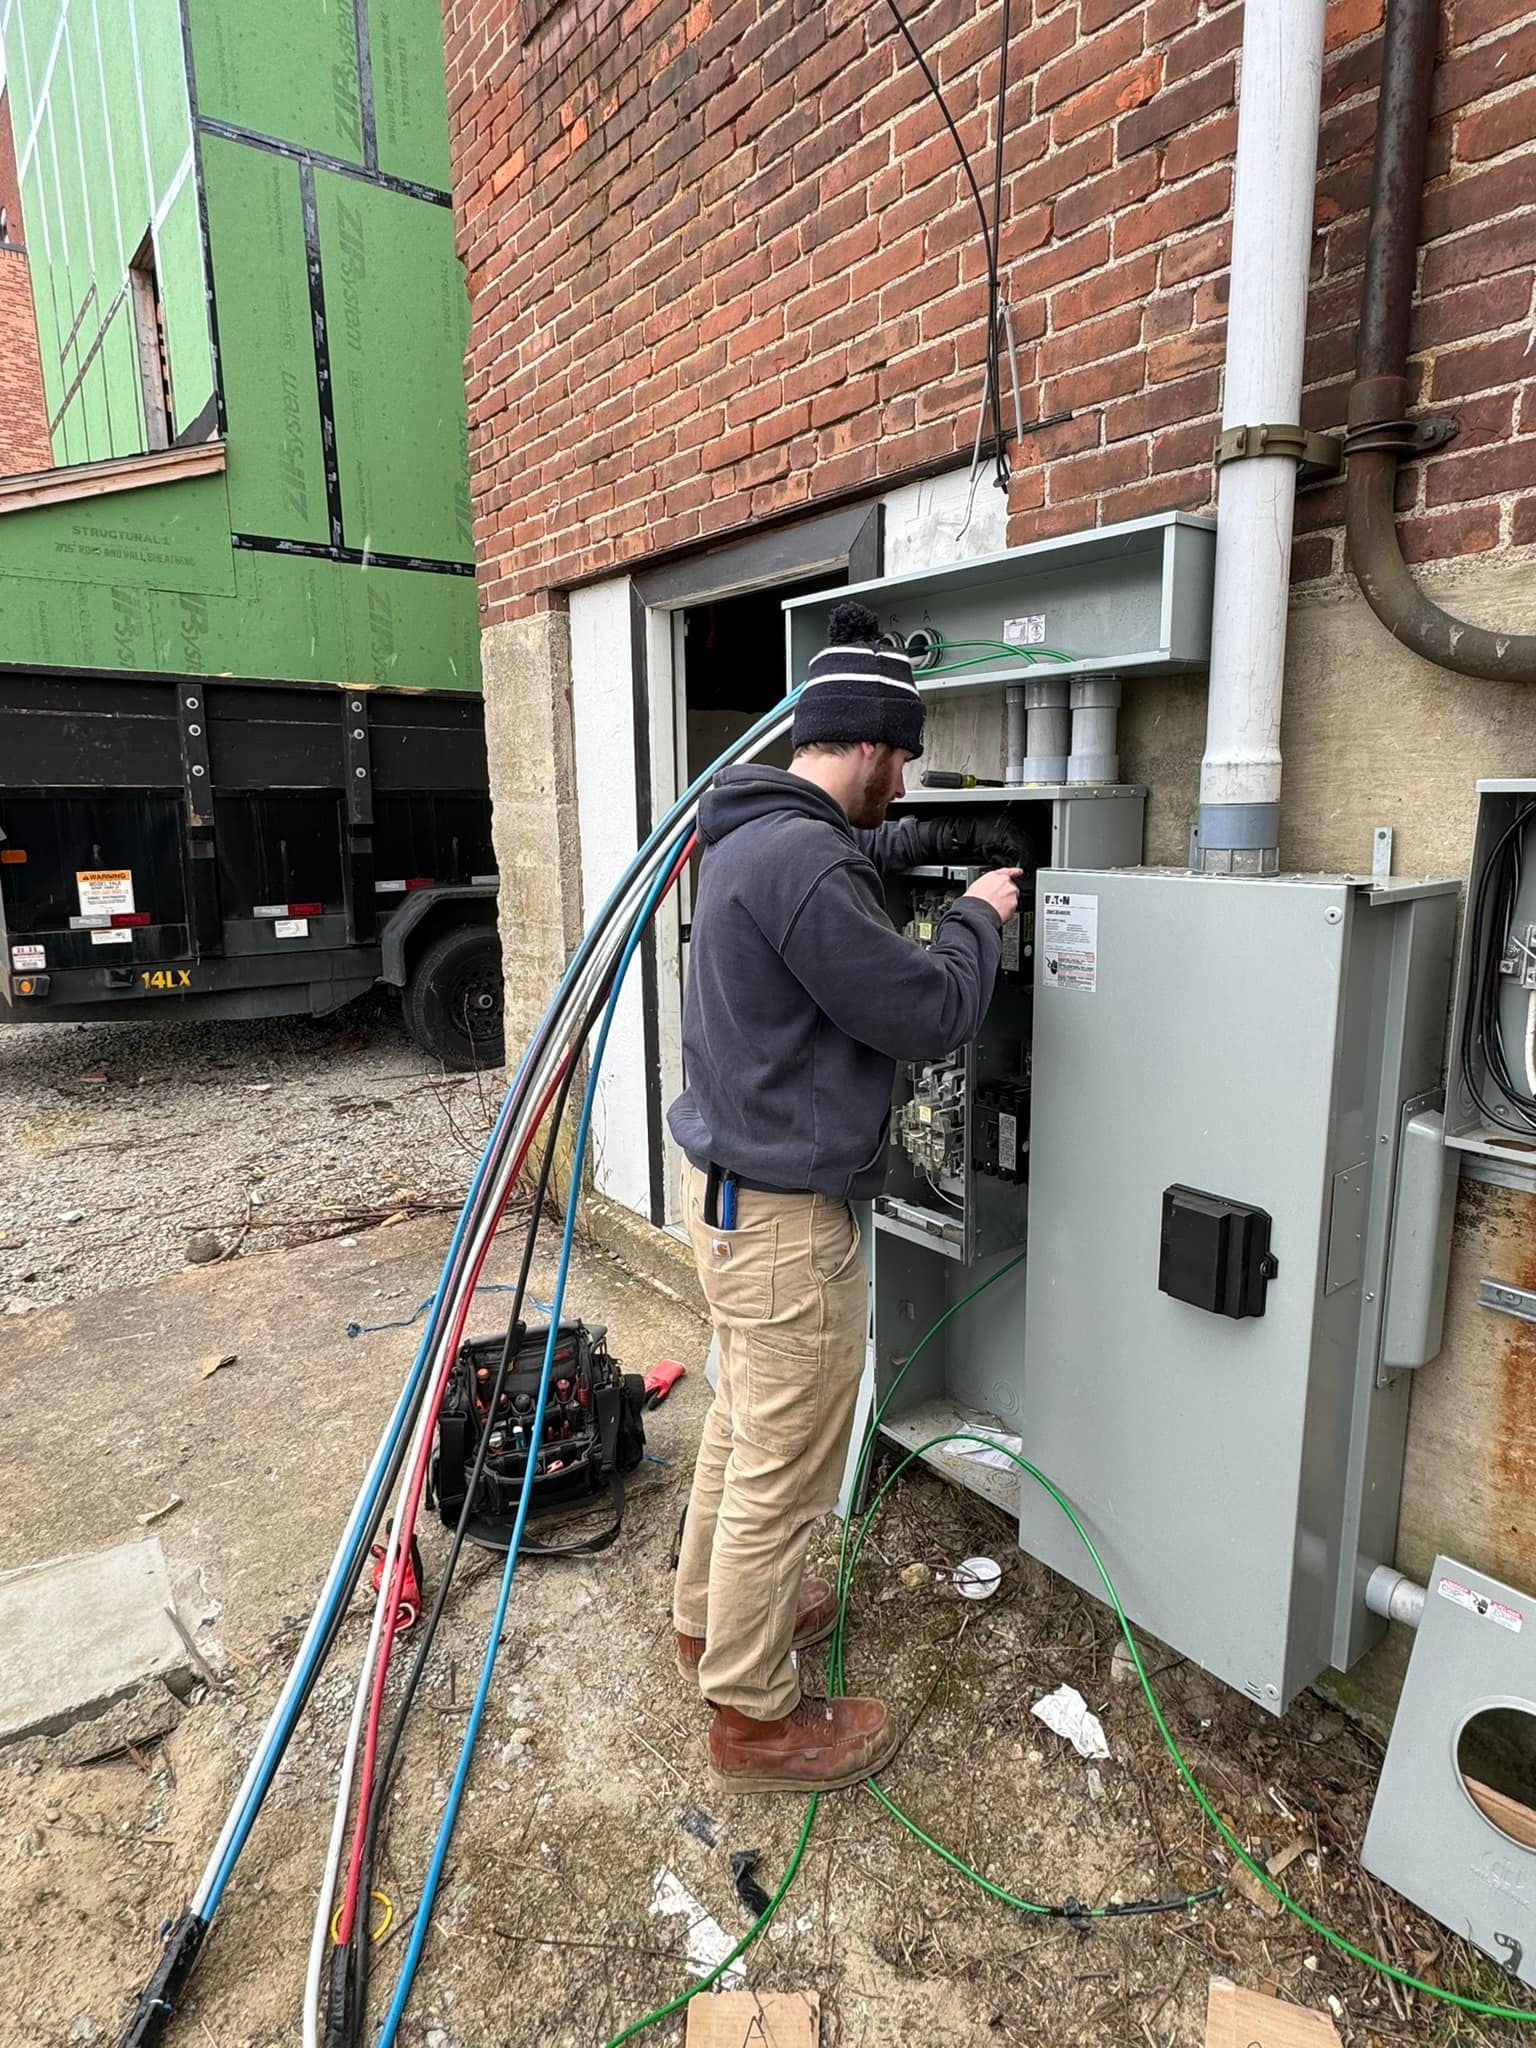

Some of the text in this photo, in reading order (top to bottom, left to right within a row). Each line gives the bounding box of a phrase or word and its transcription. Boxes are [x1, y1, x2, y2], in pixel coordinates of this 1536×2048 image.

[72, 525, 161, 545] STRUCTURAL
[123, 551, 144, 562] WALL
[89, 872, 127, 881] WARNING
[1045, 895, 1070, 905] EATON
[141, 969, 192, 989] 14LX
